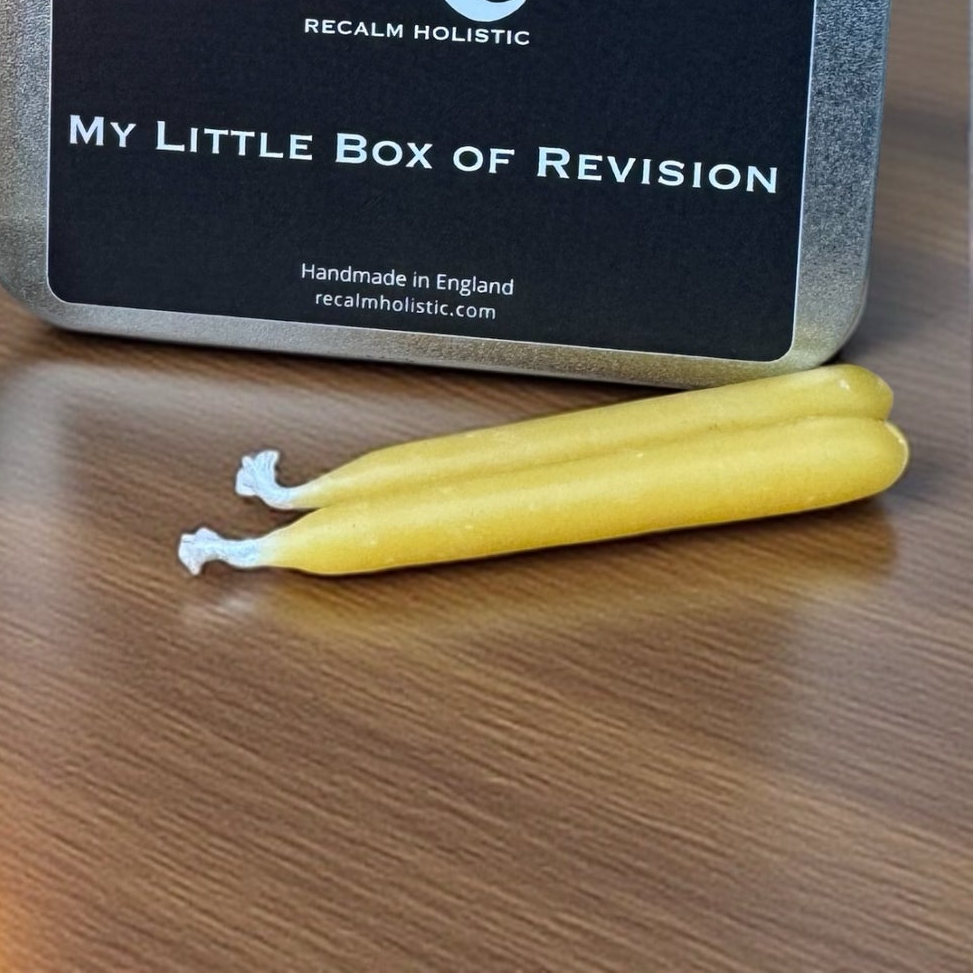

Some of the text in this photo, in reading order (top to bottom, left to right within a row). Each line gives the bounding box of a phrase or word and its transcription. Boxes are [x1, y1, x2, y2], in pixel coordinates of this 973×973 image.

[304, 18, 530, 46] RECALM HOLISTIC
[301, 262, 514, 297] Handmade in England
[315, 292, 496, 320] recalmholistic.com
